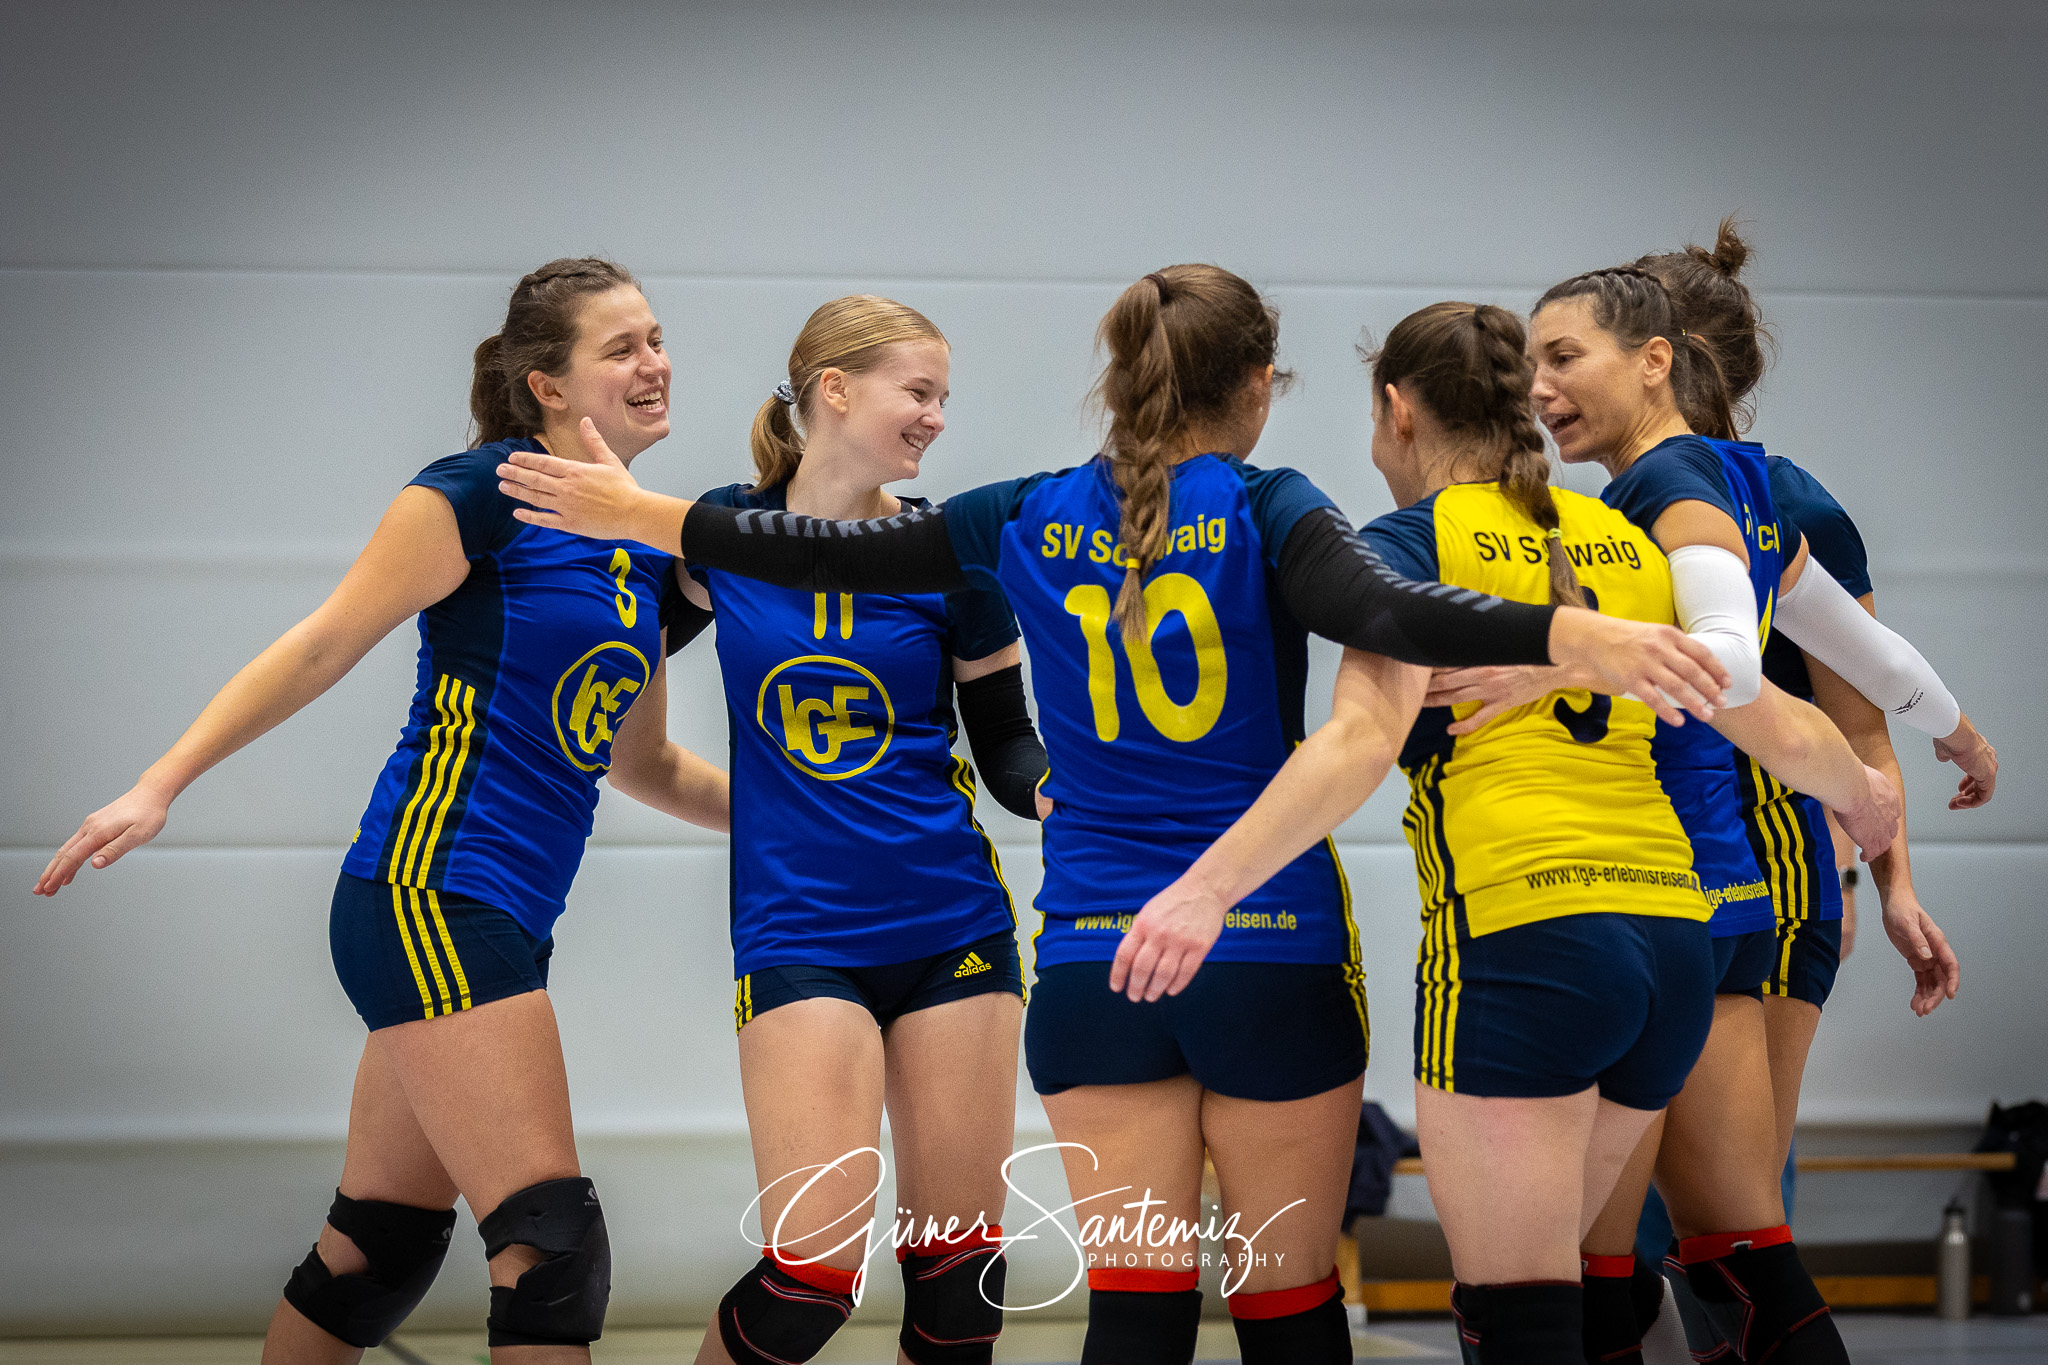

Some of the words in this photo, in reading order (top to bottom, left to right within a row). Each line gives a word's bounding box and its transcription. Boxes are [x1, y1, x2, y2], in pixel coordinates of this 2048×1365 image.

[1041, 522, 1084, 559] SV
[1474, 532, 1512, 562] SV
[609, 548, 637, 628] 3
[1064, 572, 1228, 743] 10
[778, 684, 876, 764] IGE
[954, 962, 992, 978] adidas
